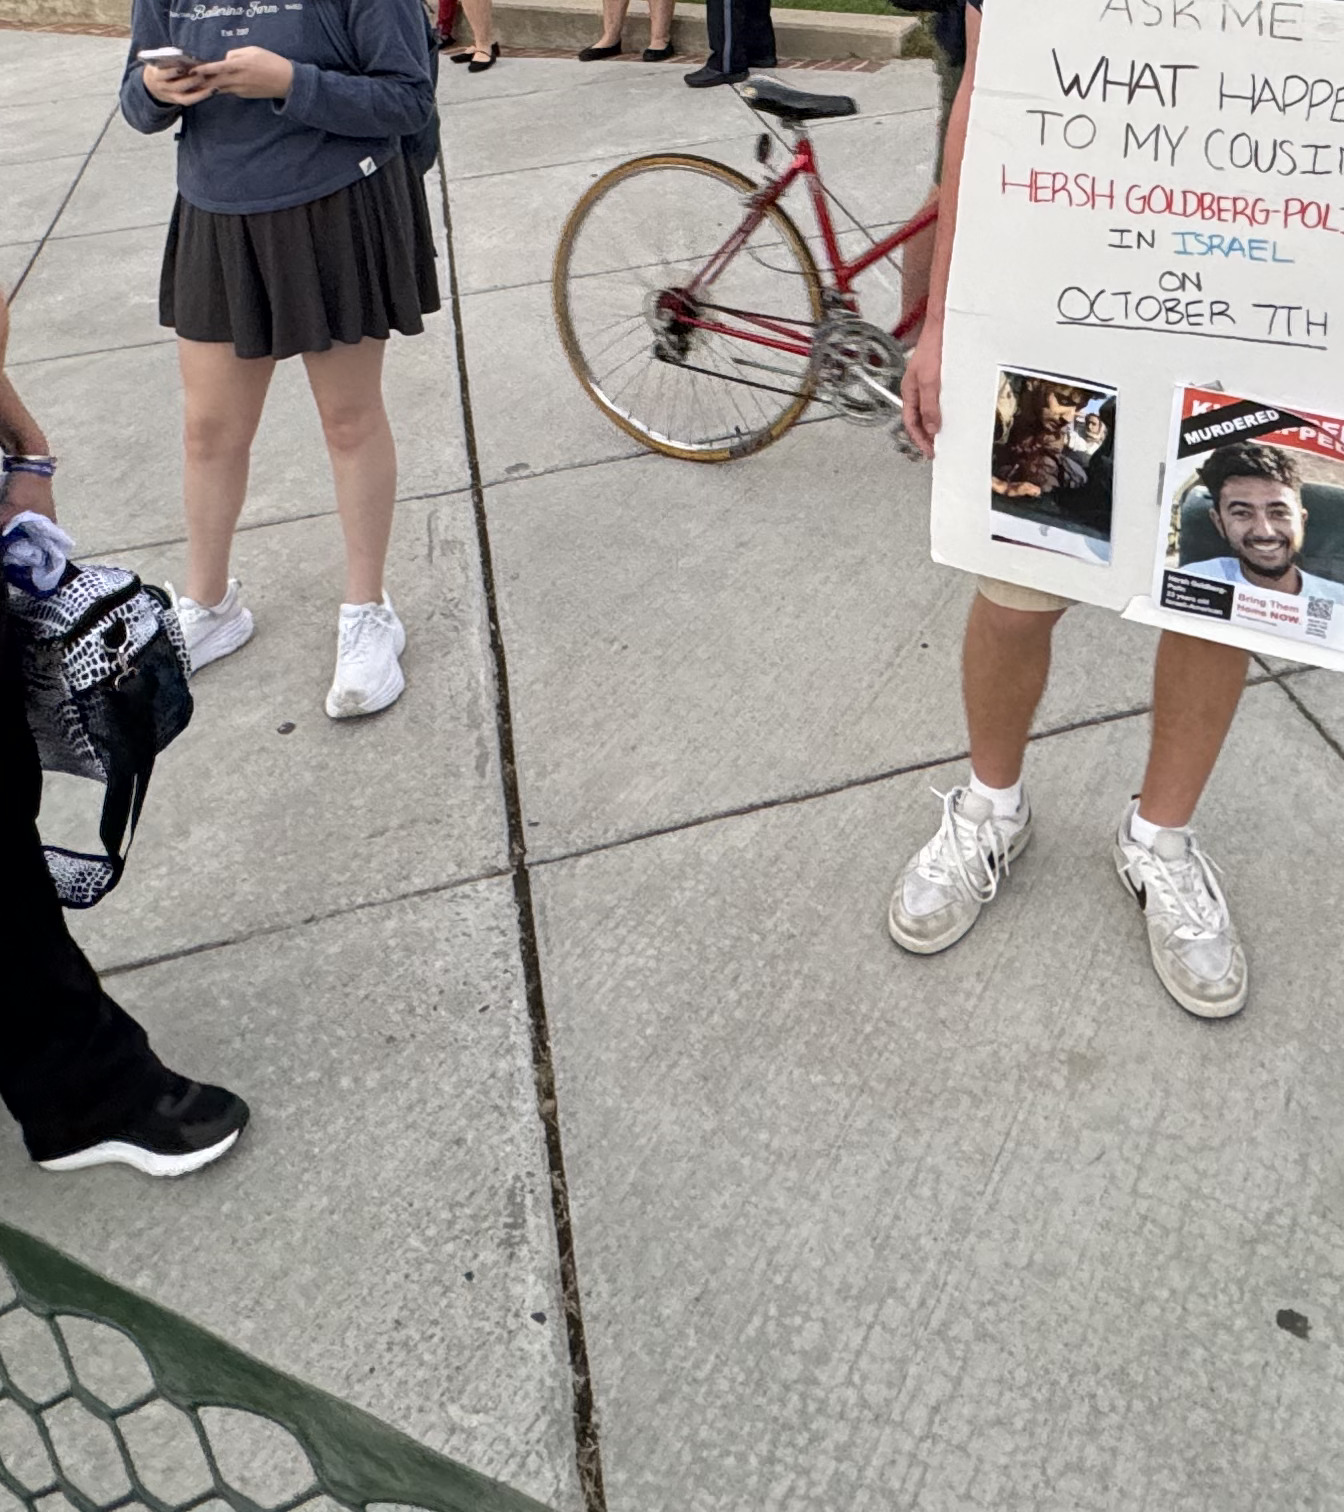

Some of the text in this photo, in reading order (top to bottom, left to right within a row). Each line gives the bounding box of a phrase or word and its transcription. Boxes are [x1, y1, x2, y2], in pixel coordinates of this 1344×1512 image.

[1221, 0, 1304, 41] ME
[1052, 48, 1199, 108] WHAT
[1025, 109, 1097, 149] TO
[1123, 122, 1189, 167] MY
[1001, 164, 1115, 210] HERSH
[1108, 228, 1295, 264] IN ISRAEL
[1158, 270, 1203, 292] ON
[1056, 286, 1329, 337] OCTOBER 7TH
[1183, 409, 1281, 446] MURDERED
[1238, 593, 1300, 613] Bring Them
